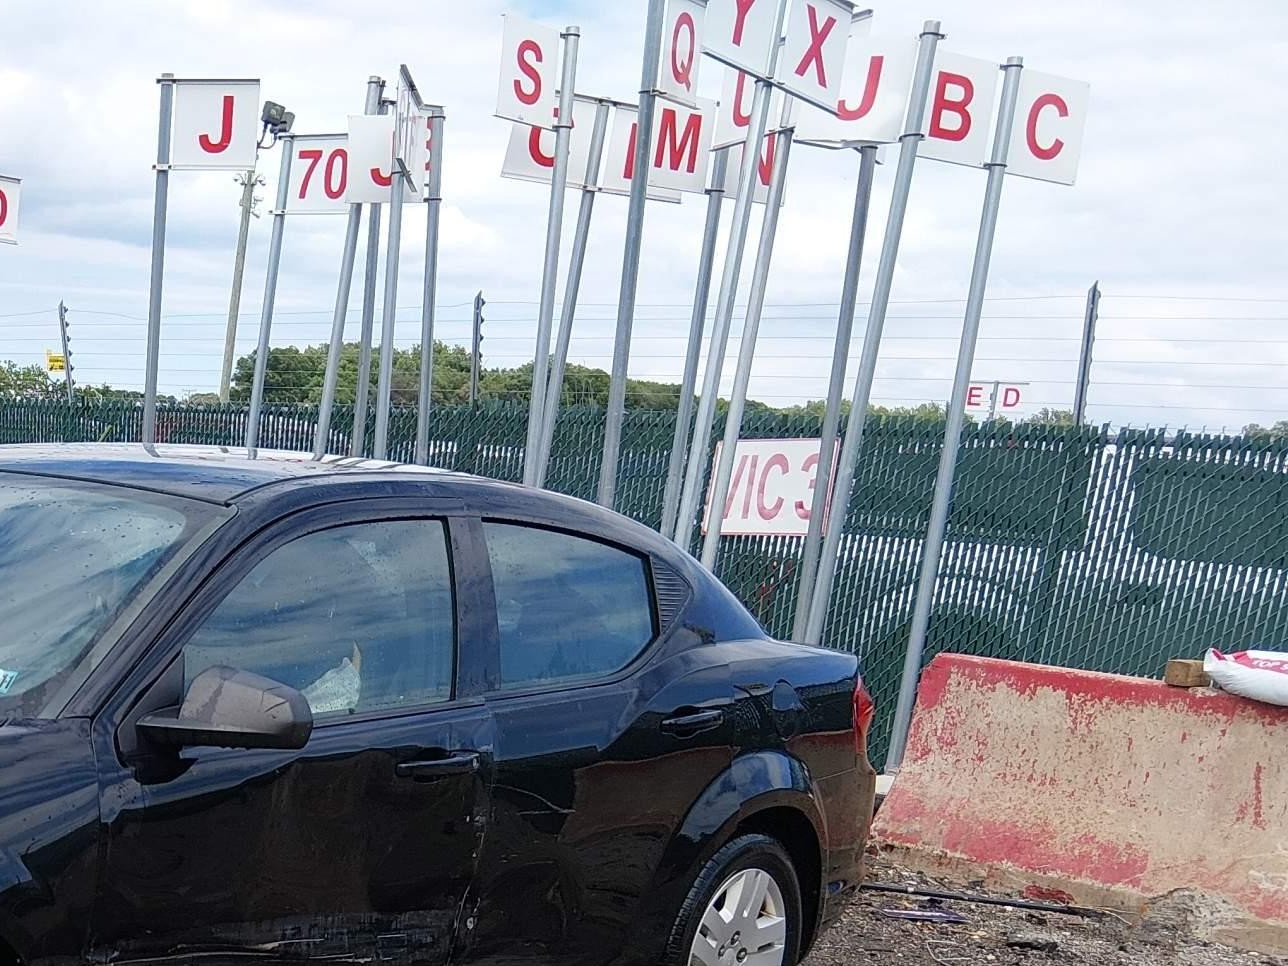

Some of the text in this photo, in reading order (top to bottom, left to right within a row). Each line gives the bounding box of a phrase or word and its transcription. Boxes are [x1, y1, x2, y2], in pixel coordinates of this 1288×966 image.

[513, 38, 544, 106] S
[671, 11, 696, 92] Q
[794, 3, 837, 89] X
[836, 55, 885, 122] J
[928, 70, 975, 142] B
[198, 95, 234, 154] J
[653, 107, 703, 174] M
[1025, 92, 1070, 161] C
[297, 148, 347, 200] 70
[966, 386, 984, 407] E
[1002, 387, 1021, 408] D
